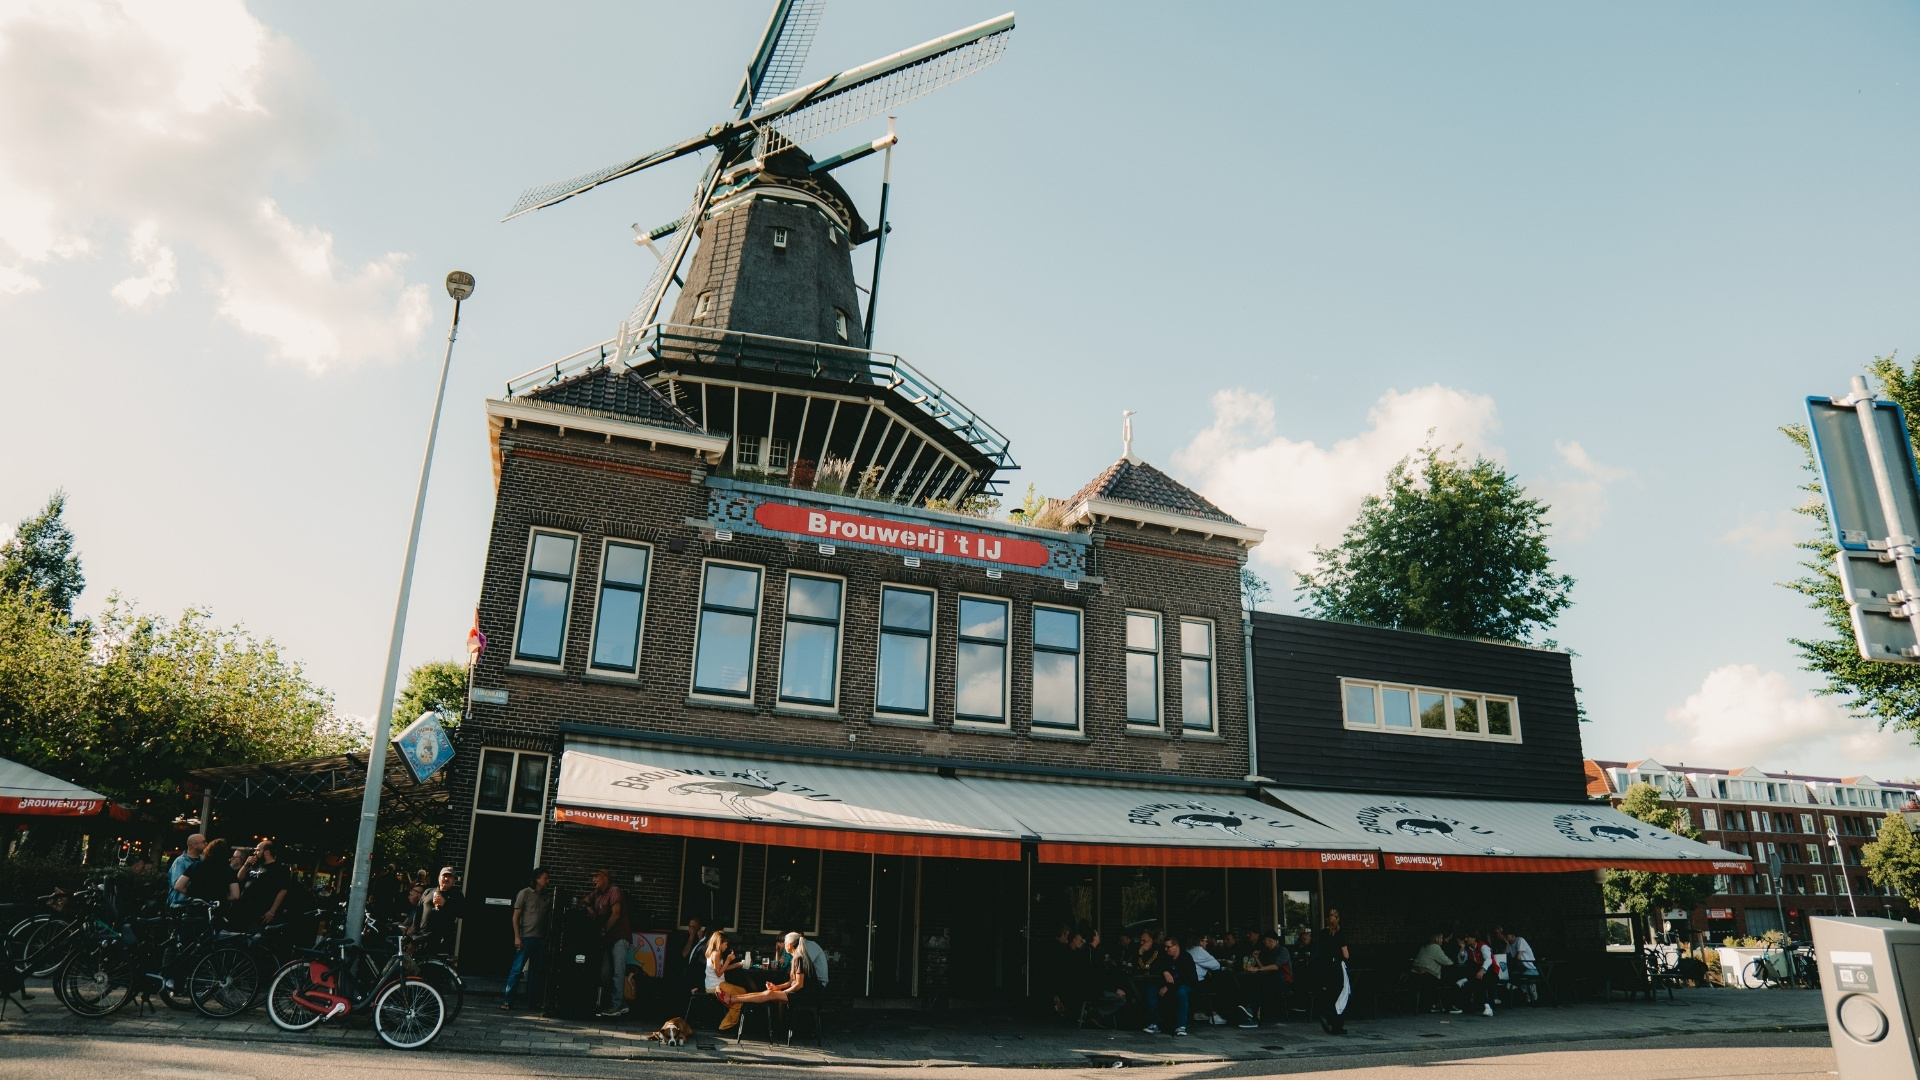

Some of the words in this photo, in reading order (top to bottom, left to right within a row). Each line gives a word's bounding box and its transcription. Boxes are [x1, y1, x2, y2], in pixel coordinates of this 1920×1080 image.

[808, 512, 944, 554] Brouwerij
[977, 538, 1001, 560] IJ
[18, 799, 79, 809] BROUWERIJ
[565, 809, 629, 823] BROUWERIJ
[1321, 853, 1361, 863] BROUWERIJ
[1395, 856, 1431, 864] BROUWERIJ
